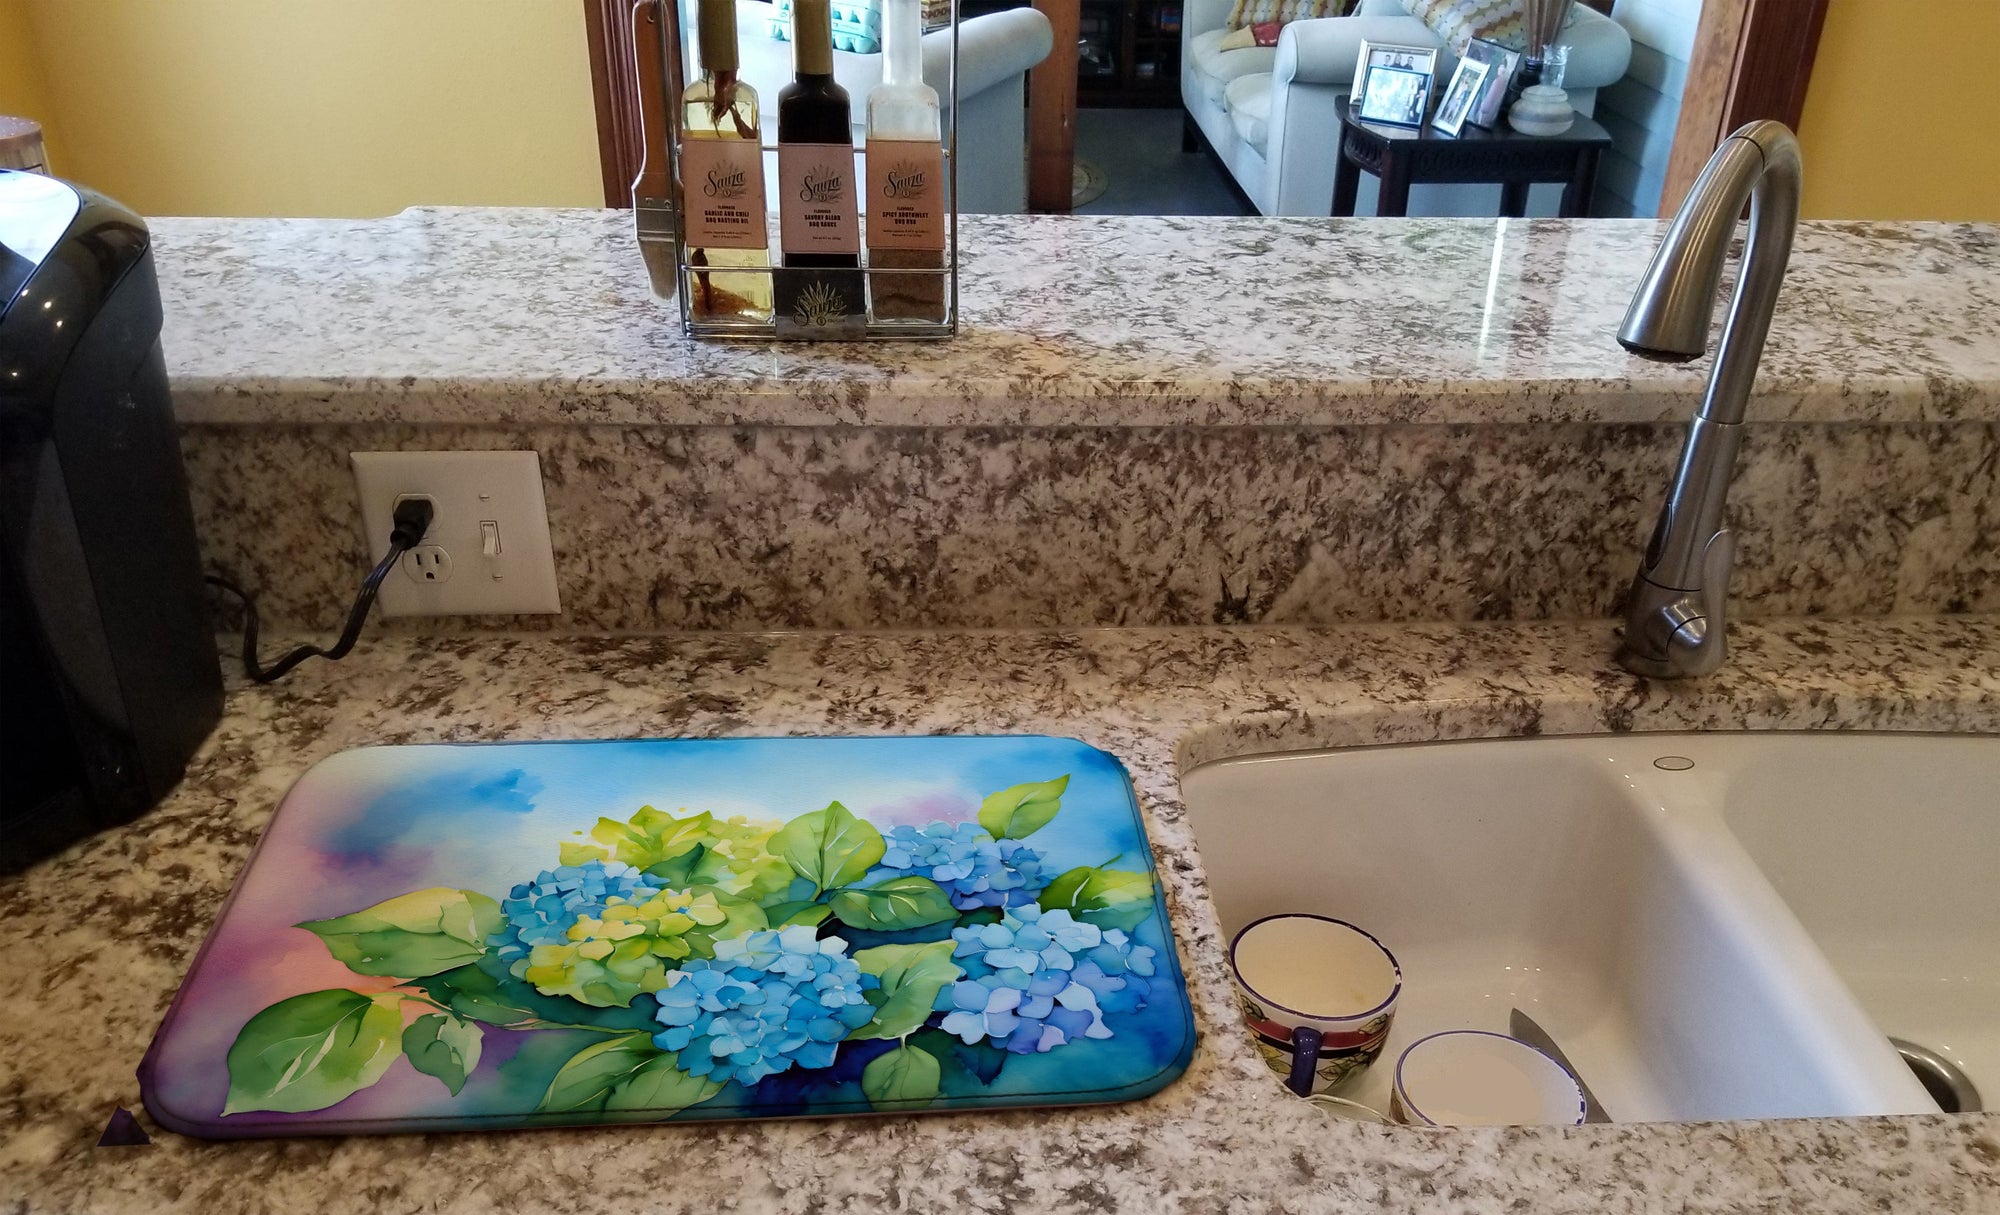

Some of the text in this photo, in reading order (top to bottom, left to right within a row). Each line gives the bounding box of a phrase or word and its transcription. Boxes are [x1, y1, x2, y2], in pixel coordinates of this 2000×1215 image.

[704, 169, 745, 197] Sauza
[800, 175, 842, 202] Sauza
[884, 170, 925, 198] Sauza
